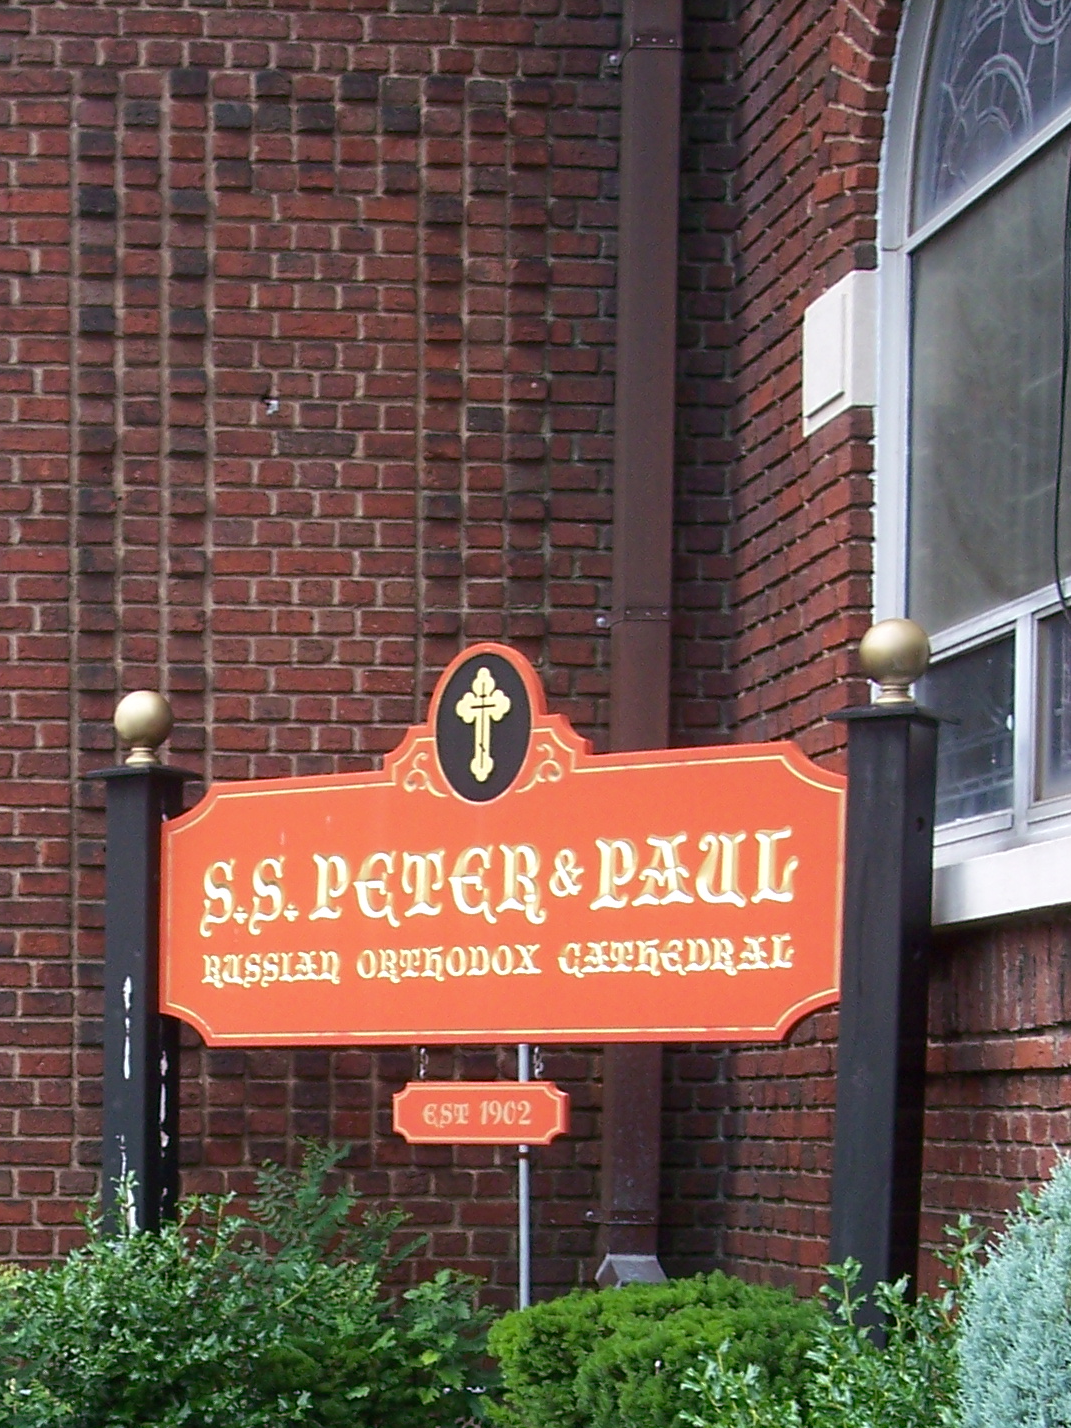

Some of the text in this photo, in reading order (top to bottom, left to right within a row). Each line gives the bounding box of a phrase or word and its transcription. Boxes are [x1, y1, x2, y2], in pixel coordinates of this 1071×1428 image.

[198, 827, 799, 937] S.S. PETER & PAUL
[200, 933, 794, 988] RUSSIAN ORTHODOX CATHEDRAL
[422, 1099, 533, 1127] EST 1902
